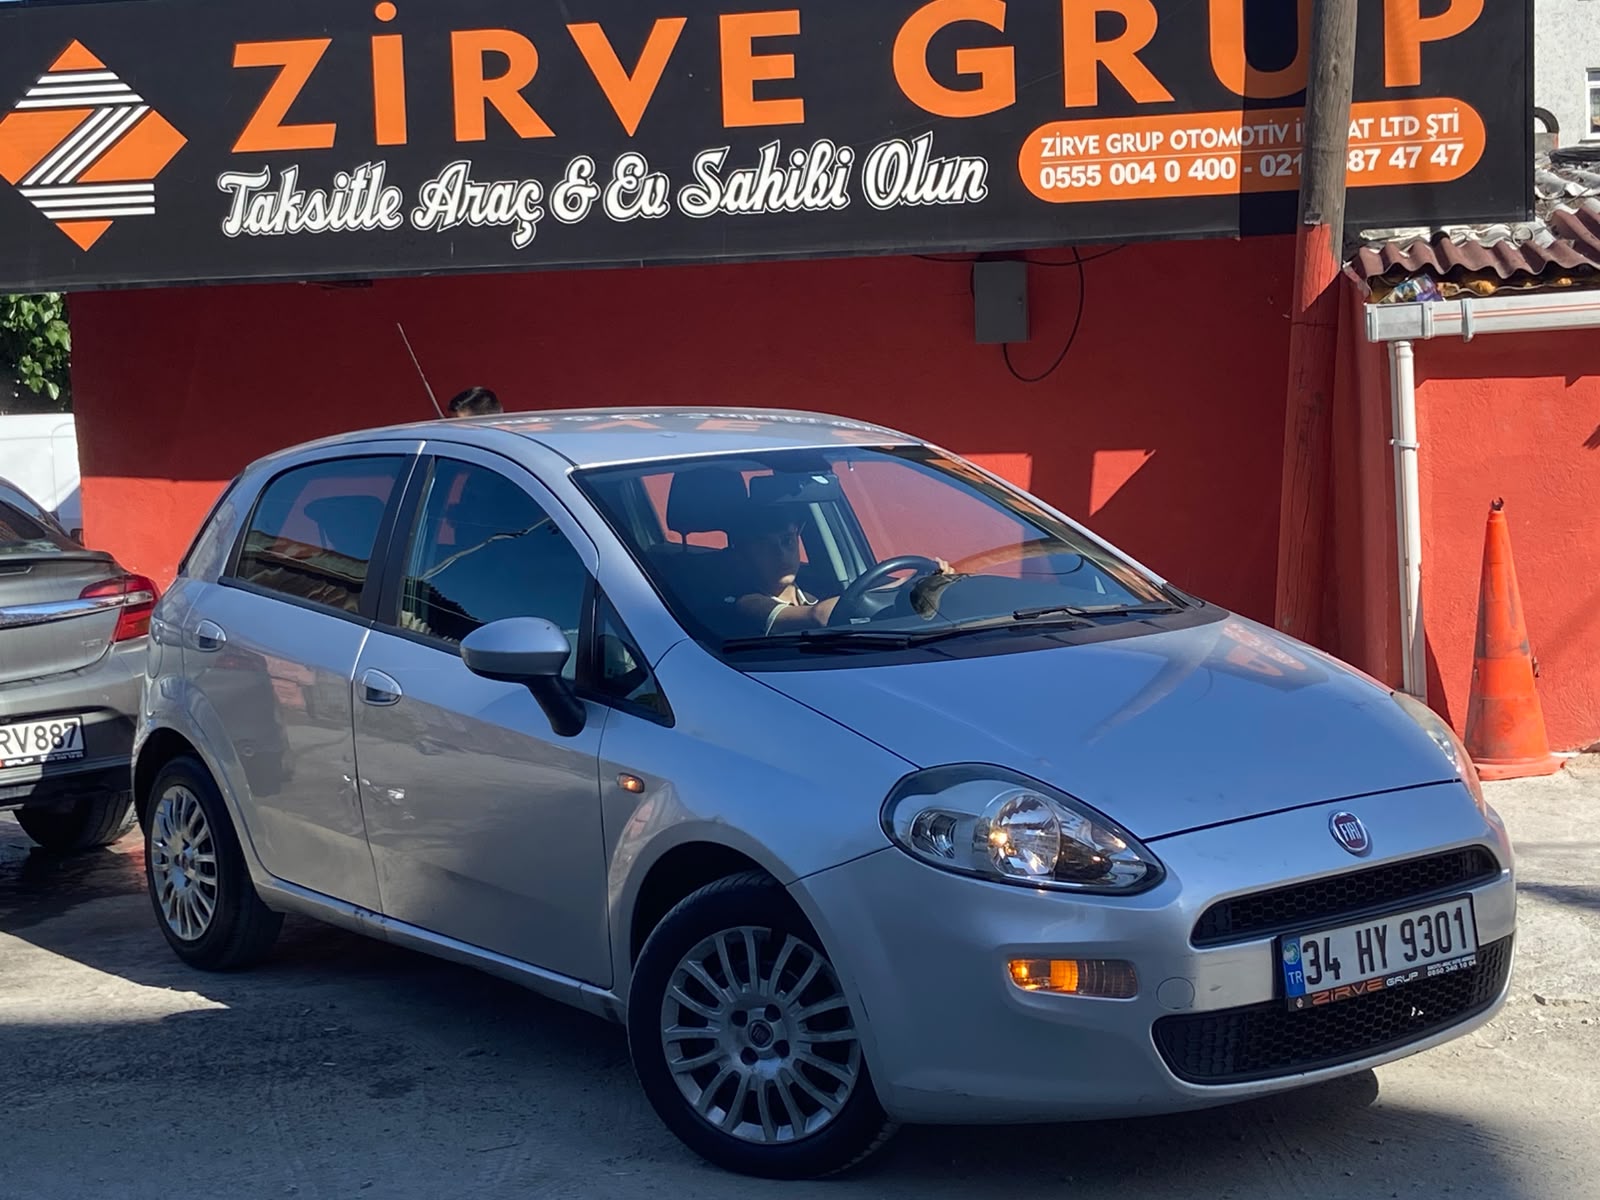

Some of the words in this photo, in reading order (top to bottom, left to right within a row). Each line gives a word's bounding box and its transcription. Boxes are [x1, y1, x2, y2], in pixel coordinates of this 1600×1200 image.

[232, 2, 804, 153] ZİRVE
[893, 0, 1484, 118] GRUP
[1040, 132, 1100, 157] ZİRVE
[1106, 132, 1164, 154] GRUP
[1170, 119, 1289, 150] OTOMOTİV
[1380, 115, 1421, 137] LTD
[1426, 107, 1459, 140] ŞTİ
[217, 161, 403, 237] Taksitle
[411, 160, 544, 249] Araç
[550, 155, 599, 224] &
[677, 138, 855, 218] Sahibi
[862, 131, 989, 211] Olun
[1040, 165, 1101, 189] 0555
[1109, 161, 1157, 185] 004
[1164, 160, 1180, 183] 0
[1188, 157, 1237, 181] 400
[1260, 153, 1303, 177] 021
[1346, 148, 1381, 172] 87
[1388, 146, 1422, 169] 47
[1430, 143, 1464, 167] 47
[1338, 821, 1362, 842] FIAT
[1302, 937, 1341, 985] 34
[1355, 924, 1387, 975] HY
[1400, 907, 1467, 963] 9301
[1288, 971, 1303, 985] TR
[1386, 971, 1419, 987] GRUP
